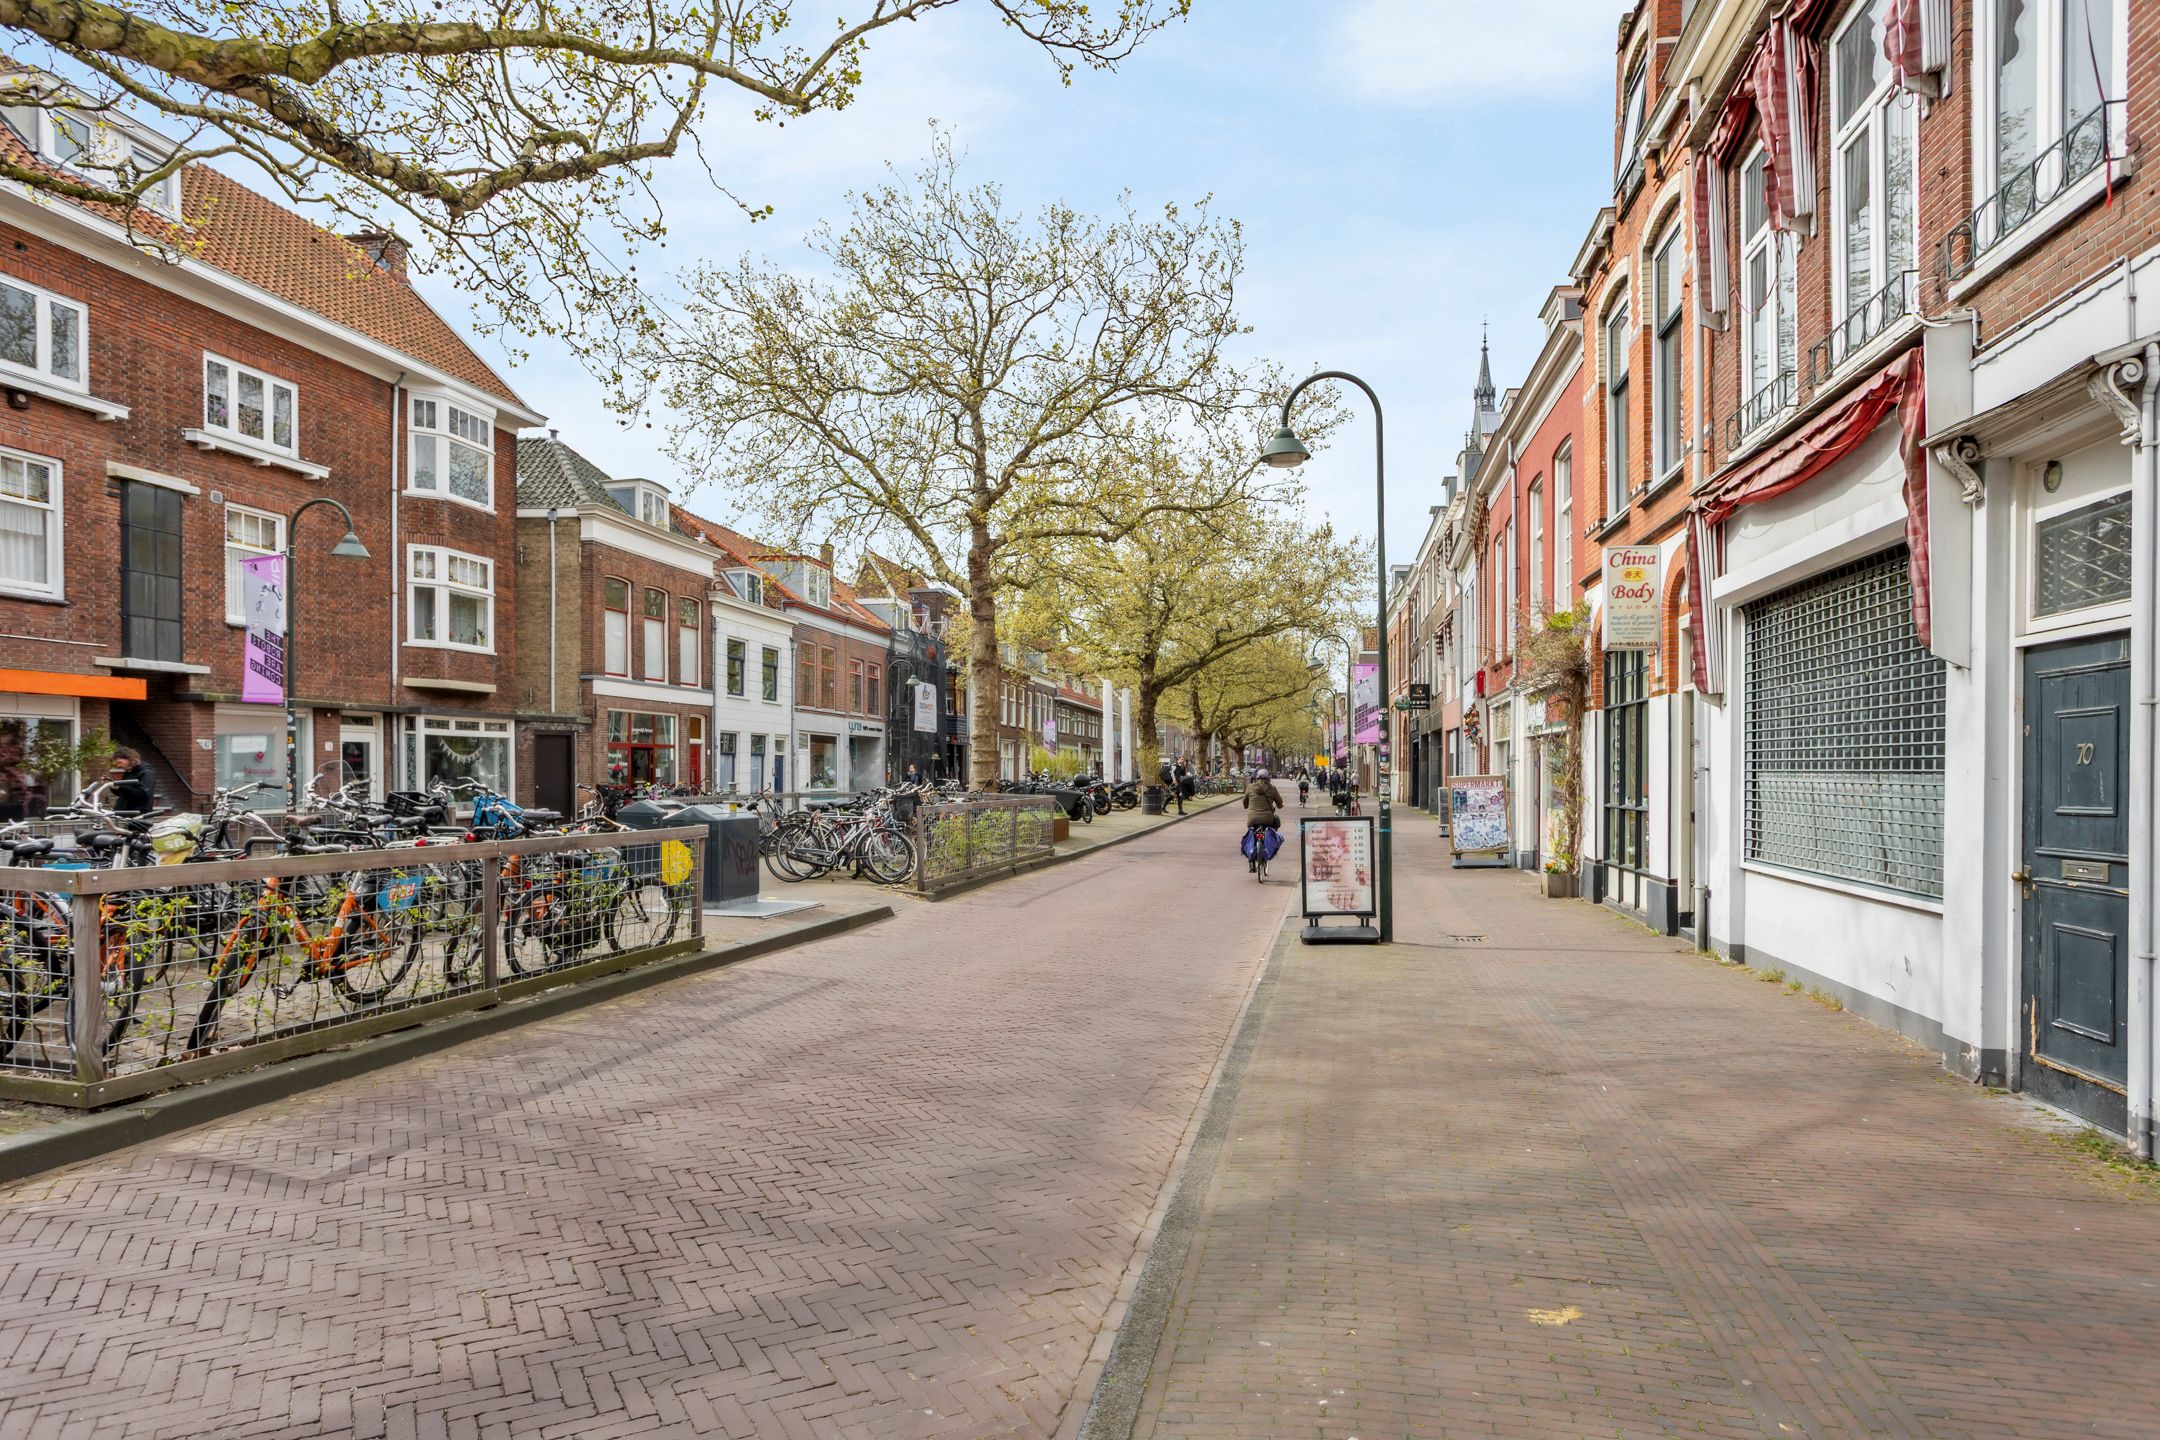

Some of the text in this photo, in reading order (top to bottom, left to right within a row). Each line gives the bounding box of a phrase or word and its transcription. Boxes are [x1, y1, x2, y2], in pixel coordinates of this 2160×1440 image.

[1609, 550, 1657, 568] China
[1611, 582, 1655, 603] Body
[2075, 743, 2094, 765] 70
